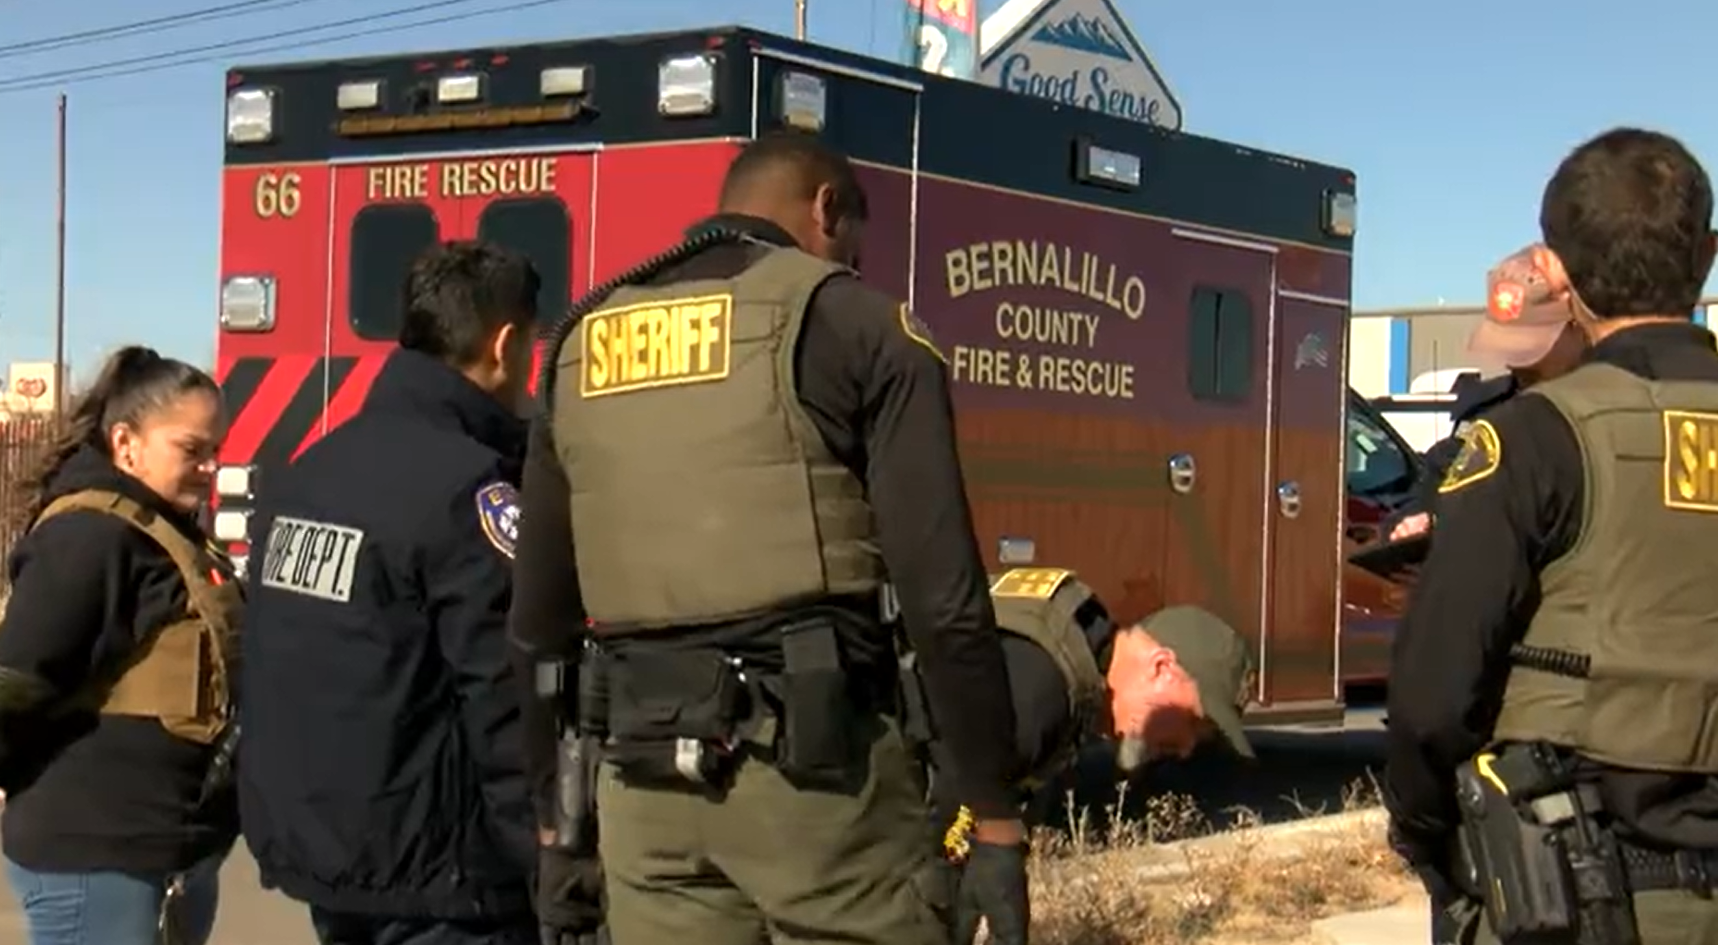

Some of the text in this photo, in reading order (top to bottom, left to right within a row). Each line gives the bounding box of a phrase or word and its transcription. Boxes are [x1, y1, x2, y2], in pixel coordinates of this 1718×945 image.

[1000, 53, 1160, 123] Good Sense
[255, 174, 301, 217] 66
[367, 158, 557, 199] FIRE RESCUE
[945, 239, 1146, 320] BERNALILLO
[590, 302, 722, 388] SHERIFF
[995, 302, 1100, 348] COUNTY
[953, 346, 1135, 398] FIRE & RESCUE
